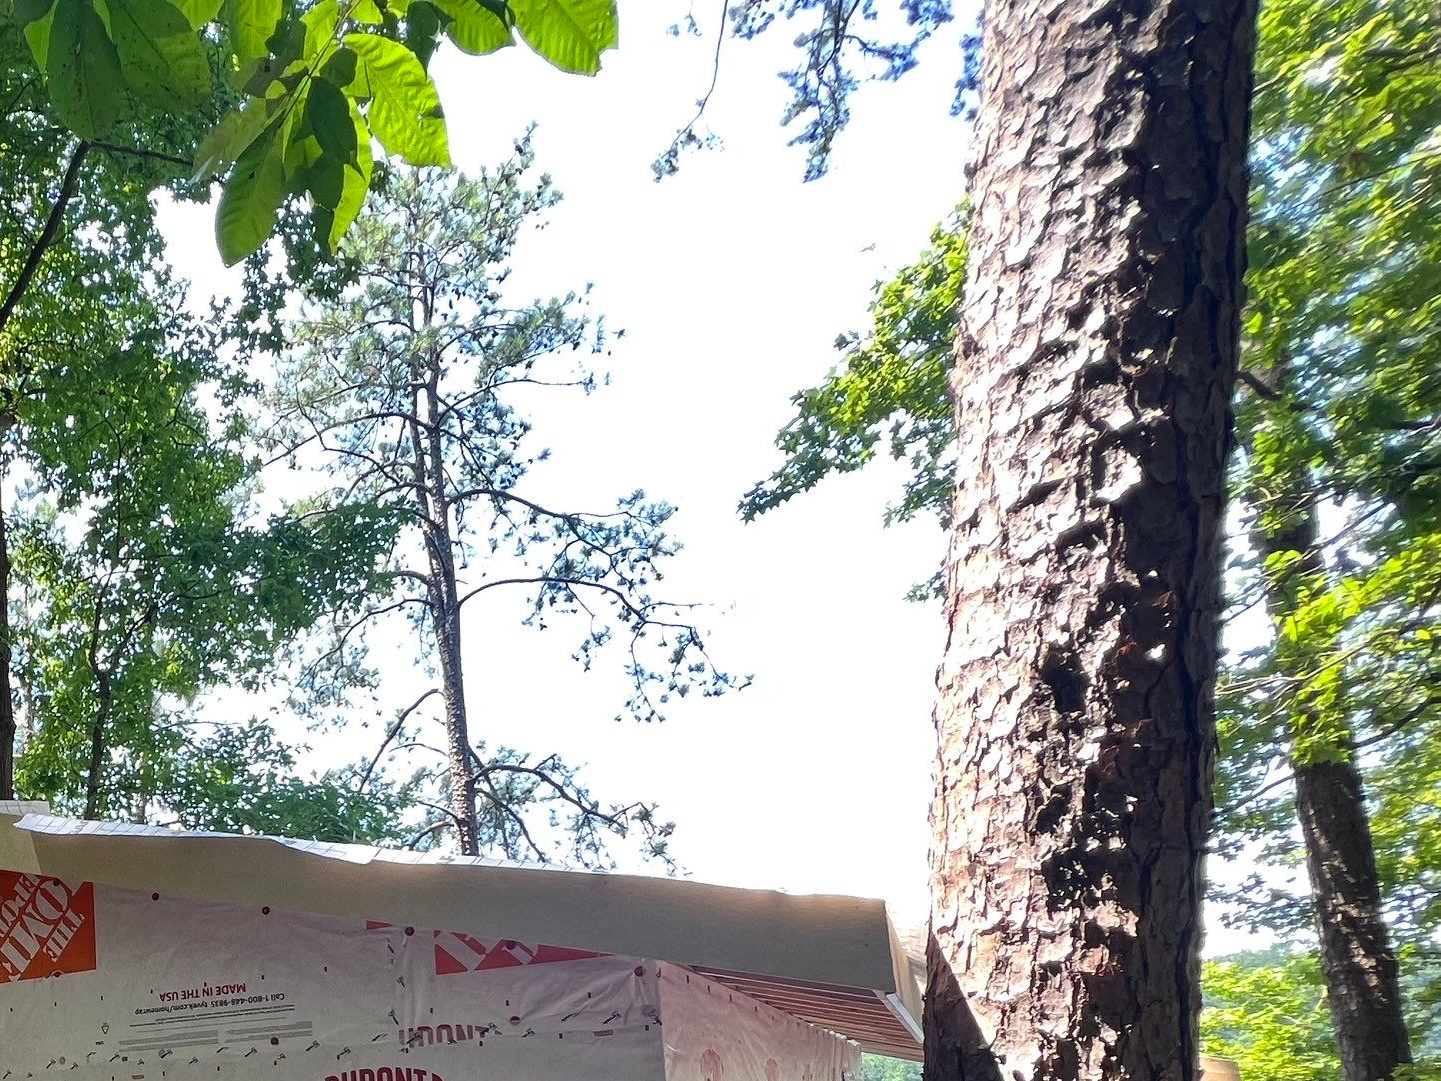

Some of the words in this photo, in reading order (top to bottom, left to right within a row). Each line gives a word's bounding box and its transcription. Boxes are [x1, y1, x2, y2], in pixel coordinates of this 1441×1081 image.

[181, 988, 200, 999] THE
[202, 988, 213, 997] IN
[216, 983, 246, 996] MADE
